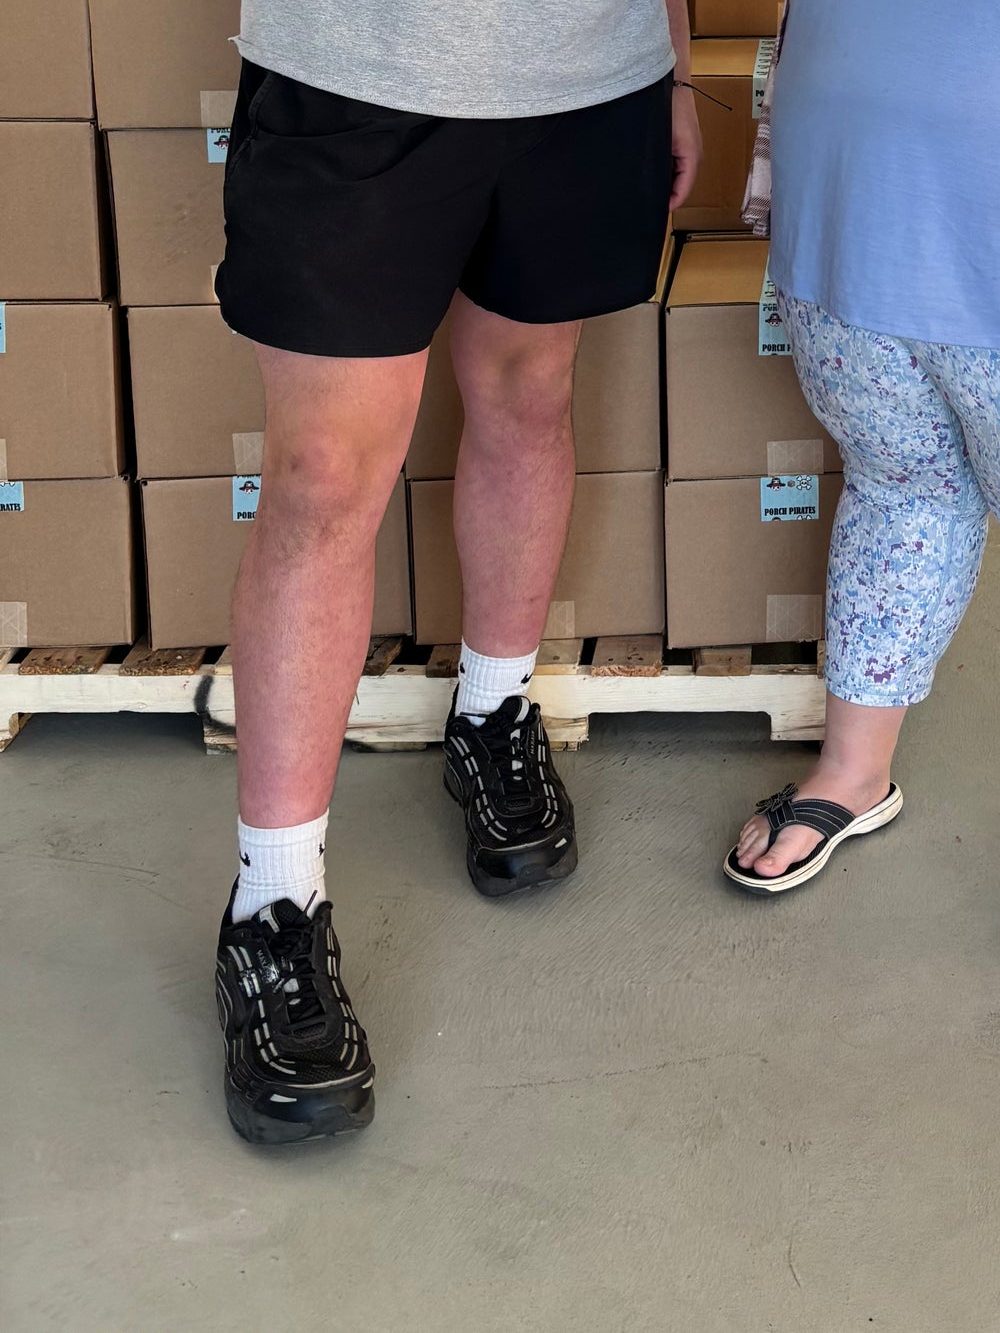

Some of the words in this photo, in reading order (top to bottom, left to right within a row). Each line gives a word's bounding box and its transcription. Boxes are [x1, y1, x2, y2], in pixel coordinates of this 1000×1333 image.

[762, 303, 778, 312] POR
[762, 344, 785, 352] PORCH
[0, 503, 21, 511] RATES
[764, 507, 787, 516] PORCH
[789, 506, 816, 514] PIRATES
[237, 511, 257, 519] PORC
